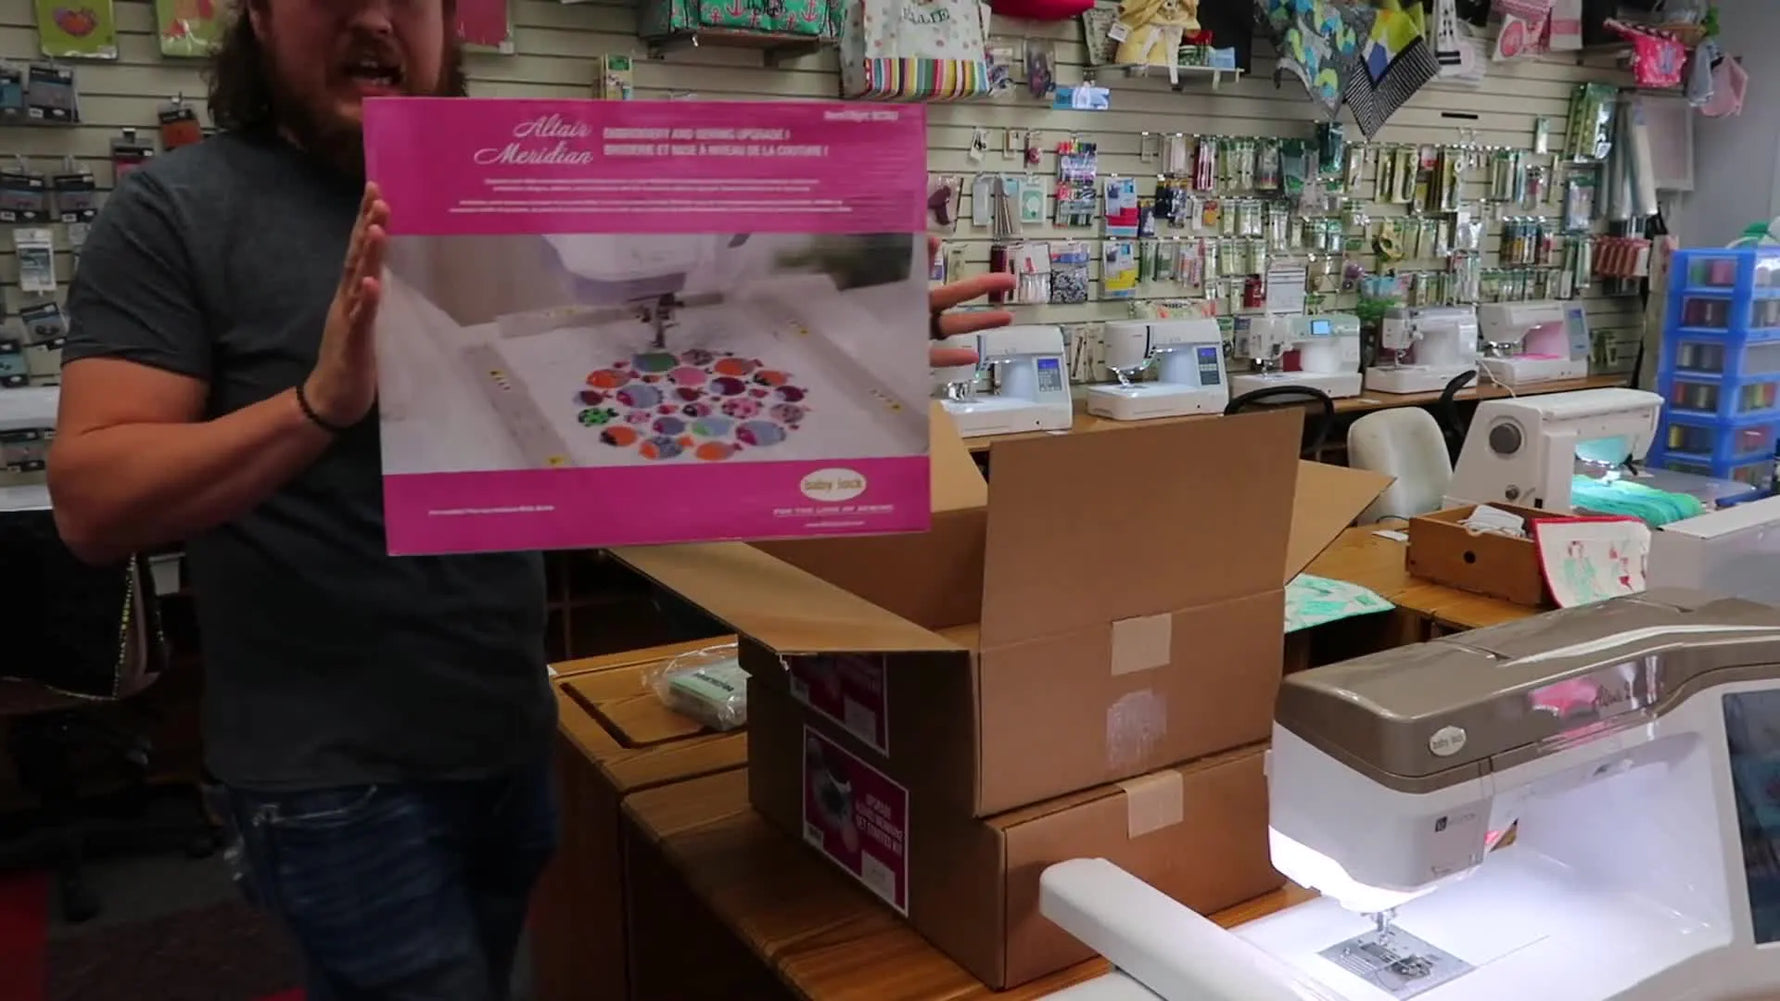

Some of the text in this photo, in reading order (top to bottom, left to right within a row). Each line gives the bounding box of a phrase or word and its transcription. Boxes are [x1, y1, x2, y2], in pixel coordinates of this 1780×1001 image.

[513, 113, 592, 138] Altair
[474, 140, 594, 165] Meridian
[804, 478, 832, 493] baby
